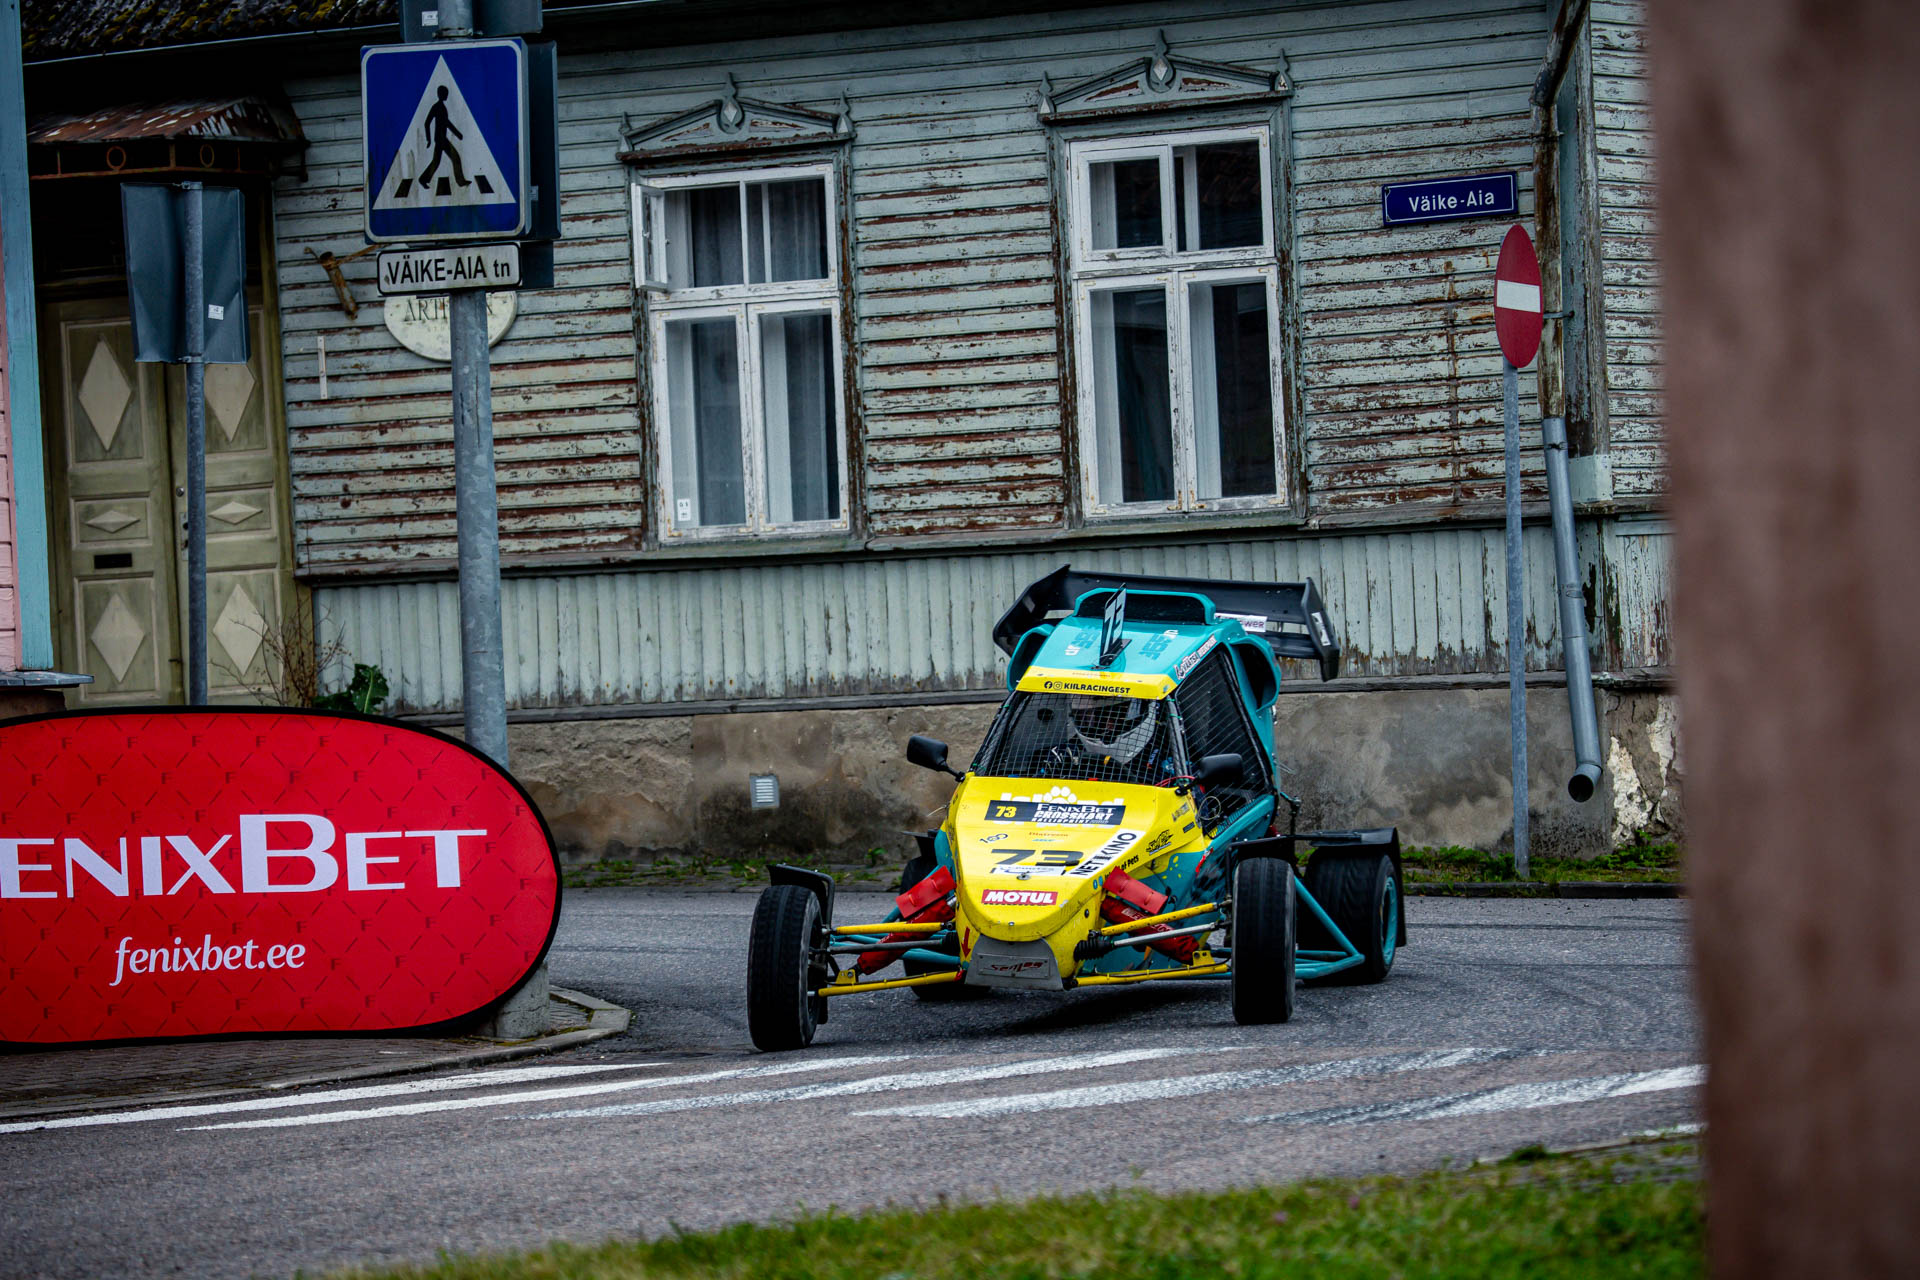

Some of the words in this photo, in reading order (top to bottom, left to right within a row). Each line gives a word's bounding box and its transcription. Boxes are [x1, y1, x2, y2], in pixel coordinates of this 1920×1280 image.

[1408, 190, 1495, 212] Väike-Aia
[387, 255, 487, 284] VÄIKE-AIA
[493, 259, 511, 278] tn
[1063, 683, 1131, 694] KIILRACINGEST
[995, 806, 1017, 818] 73
[1033, 810, 1114, 821] CROSSKART
[991, 848, 1084, 867] 73
[984, 891, 1054, 904] MOTUL
[109, 934, 306, 986] fenixbet.ee
